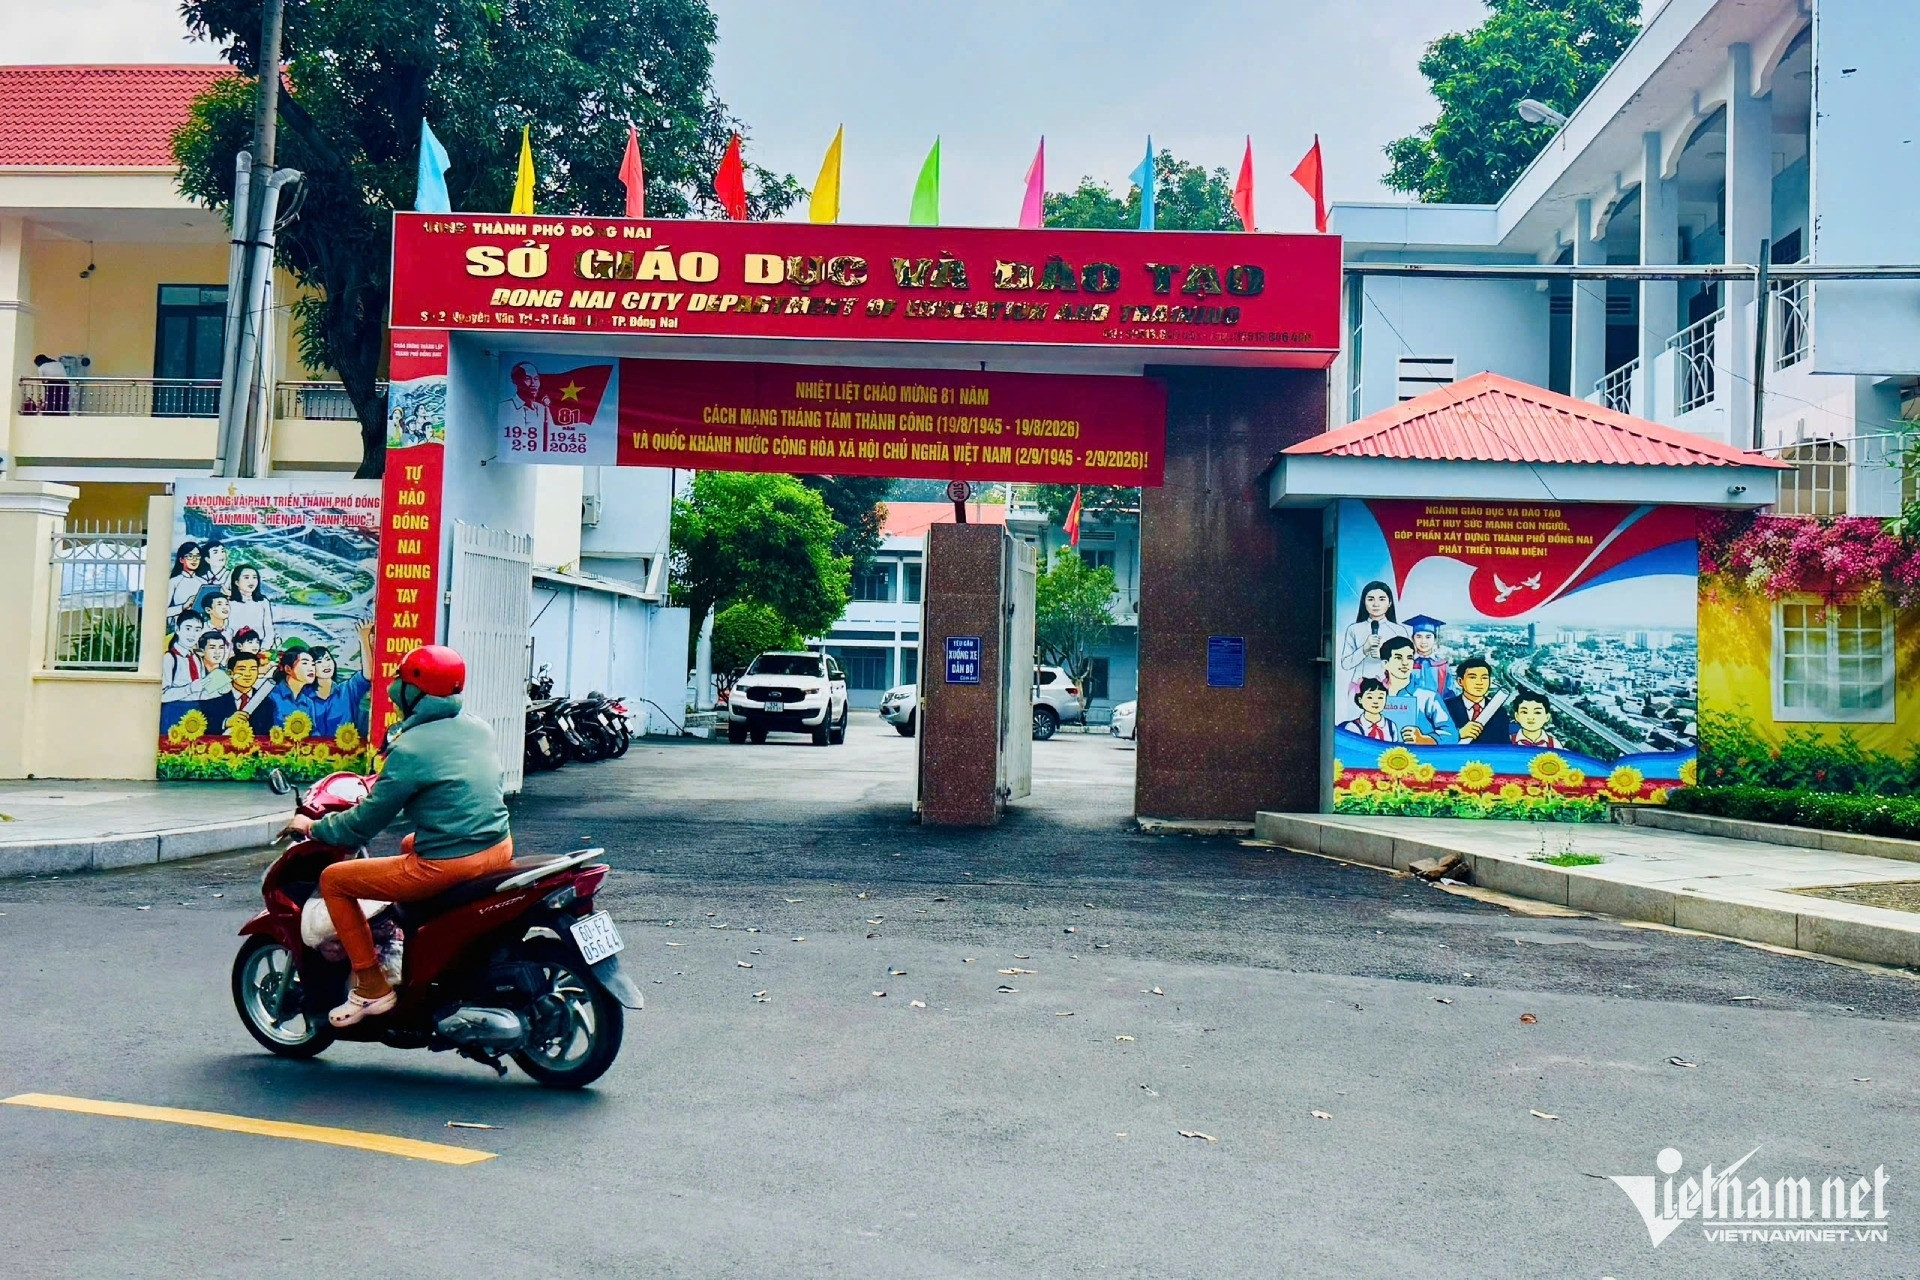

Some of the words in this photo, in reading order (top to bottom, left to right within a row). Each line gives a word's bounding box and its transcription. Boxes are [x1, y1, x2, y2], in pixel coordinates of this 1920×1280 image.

[473, 220, 526, 236] THÀNH
[532, 221, 564, 236] PHỐ
[571, 222, 618, 237] ĐỒG
[623, 225, 652, 238] NAI
[465, 239, 549, 279] SỞ
[574, 245, 719, 281] GIÁO
[744, 253, 868, 291] DỤC
[891, 250, 969, 290] VÀ
[995, 254, 1121, 294] ĐÀO
[1145, 262, 1265, 299] TẠO
[569, 290, 617, 310] NAI
[621, 292, 684, 312] CITY
[687, 293, 859, 315] DEPARTMENT
[866, 298, 897, 317] OF
[1054, 303, 1110, 322] AND
[1119, 305, 1241, 324] TRAINING
[611, 317, 627, 327] TP.
[629, 316, 656, 329] Đồng
[659, 317, 678, 328] Nai
[795, 379, 832, 403] NHIỆT
[835, 380, 859, 404] LIỆT
[863, 381, 897, 403] CHÀO
[900, 384, 937, 404] MỪNG
[941, 388, 955, 405] 81
[959, 385, 989, 406] NĂM
[558, 408, 580, 425] 81
[703, 404, 736, 425] CÁCH
[740, 407, 777, 429] MẠNG
[781, 405, 821, 428] THÁNG
[825, 407, 851, 429] TÁM
[854, 408, 896, 431] THÀNH
[899, 411, 933, 433] CÔNG
[936, 415, 1003, 435] (19/8/1945
[1015, 418, 1080, 439] 19/8/2026)
[503, 426, 538, 439] 19-8
[550, 432, 587, 443] 1945
[511, 439, 537, 452] 2-9
[550, 443, 587, 454] 2026
[632, 429, 648, 449] VÀ
[652, 428, 686, 451] QUỐC
[689, 431, 731, 453] KHÁNH
[735, 433, 769, 455] NƯỚC
[772, 436, 806, 459] CỘNG
[809, 435, 835, 457] HÒA
[838, 437, 856, 458] XÃ
[858, 438, 879, 462] HỘI
[882, 437, 908, 459] CHỦ
[911, 441, 949, 462] NGHĨA
[953, 444, 979, 466] VIỆT
[982, 447, 1012, 464] NAM
[1015, 448, 1073, 467] (2/9/1945
[1085, 450, 1148, 470] 2/9/2026)!
[404, 465, 423, 484] TỰ
[398, 488, 425, 506] HÀO
[953, 482, 965, 500] STOP
[186, 493, 204, 507] XÂY
[249, 493, 270, 507] PHÁT
[273, 491, 299, 508] TRIỂN
[334, 493, 353, 508] PHỐ
[355, 493, 380, 508] ĐỒNG
[232, 513, 257, 524] MINH
[1425, 505, 1458, 515] NGÀNH
[1460, 505, 1482, 516] GIÁO
[1485, 507, 1504, 517] DỤC
[1506, 507, 1519, 517] VÀ
[1521, 507, 1541, 517] ĐÀO
[1543, 508, 1561, 519] TẠO
[392, 510, 429, 530] ĐỒNG
[1416, 517, 1440, 527] PHÁT
[1443, 519, 1461, 528] HUY
[1463, 518, 1482, 528] SỨC
[1485, 520, 1513, 531] MẠNH
[1516, 521, 1535, 530] CON
[1394, 530, 1413, 540] GÓP
[1415, 529, 1441, 540] PHẦN
[1443, 530, 1461, 541] XÂY
[1464, 532, 1490, 543] DỰNG
[1492, 532, 1523, 543] THÀNH
[1526, 532, 1545, 543] PHỐ
[1547, 532, 1573, 544] ĐỒNG
[1576, 535, 1593, 544] NAI
[397, 539, 421, 554] NAI
[1438, 544, 1462, 554] PHÁT
[1465, 543, 1492, 555] TRIỂN
[1495, 545, 1519, 555] TOÀN
[1521, 545, 1547, 557] DIỆN!
[385, 564, 431, 579] CHUNG
[396, 588, 418, 603] TAY
[393, 610, 418, 628] XÂY
[949, 647, 969, 660] XUỐNG
[970, 650, 977, 660] XE
[951, 660, 964, 673] DẪN
[965, 663, 974, 675] BỘ
